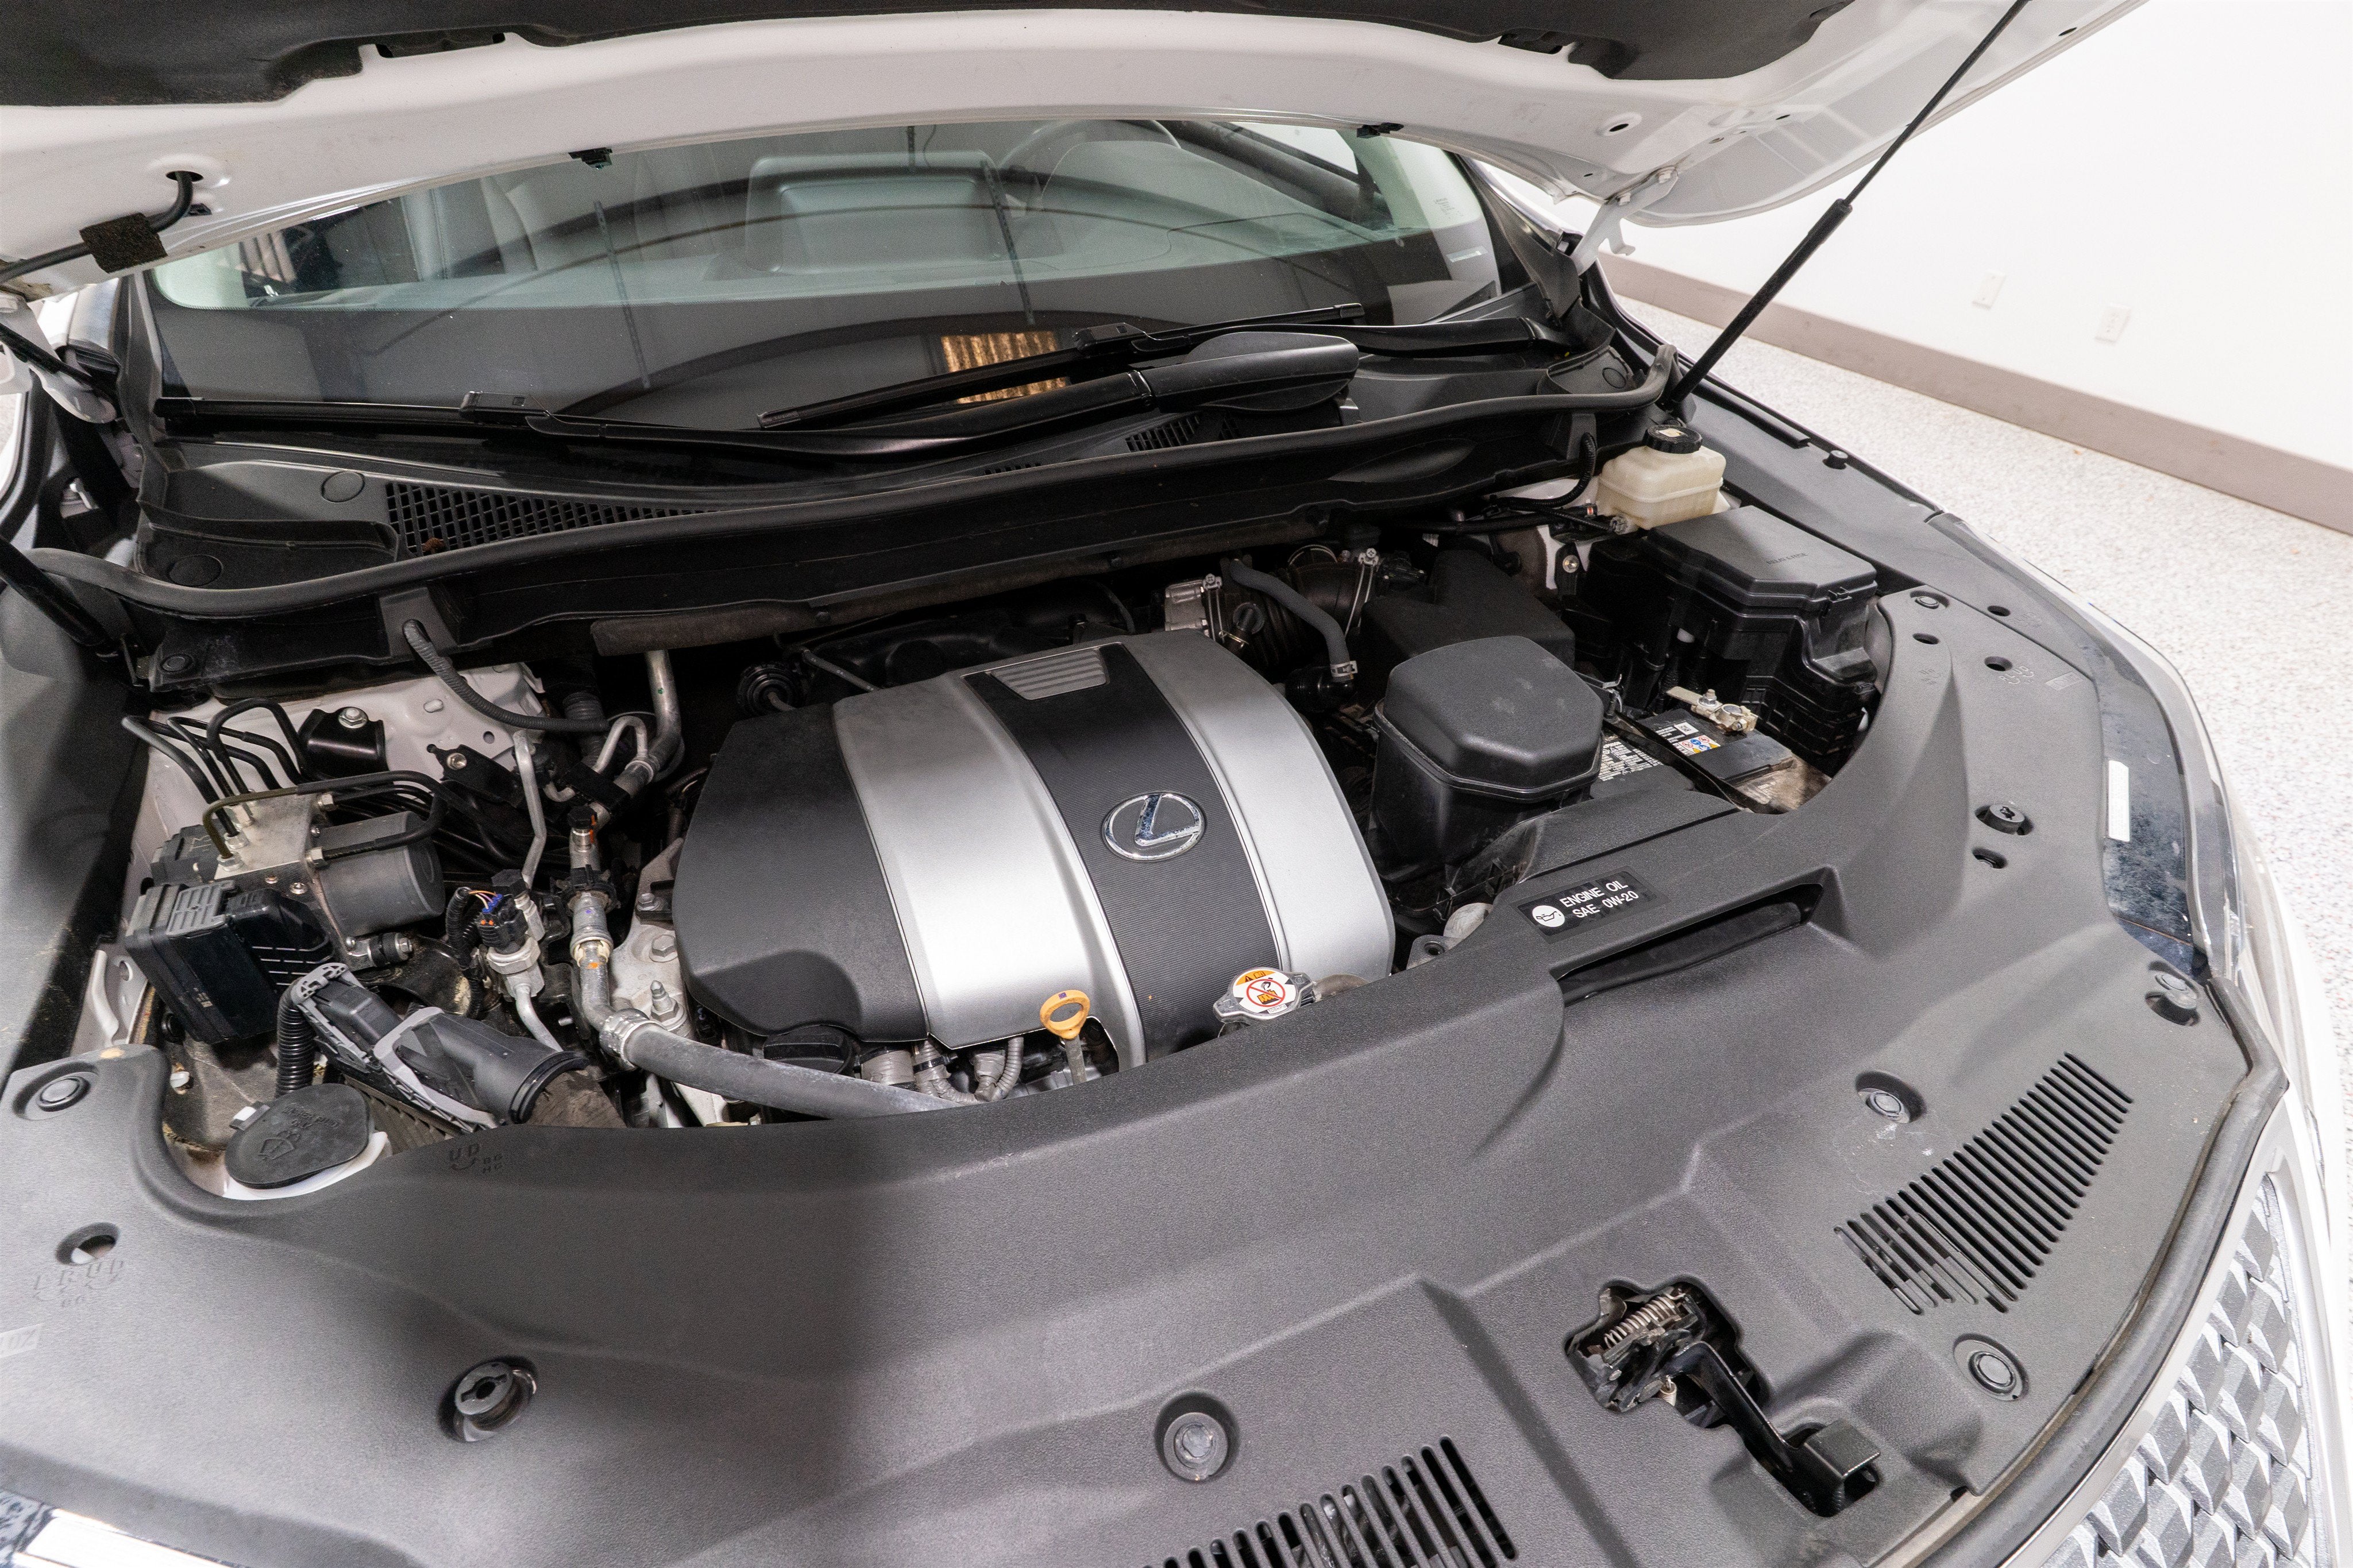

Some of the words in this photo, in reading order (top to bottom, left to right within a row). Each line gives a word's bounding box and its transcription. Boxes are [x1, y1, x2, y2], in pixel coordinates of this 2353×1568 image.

[1559, 887, 1605, 907] ENGINE
[1606, 880, 1629, 891] OIL
[1572, 903, 1600, 918] SAE
[1602, 890, 1639, 908] 0W-20
